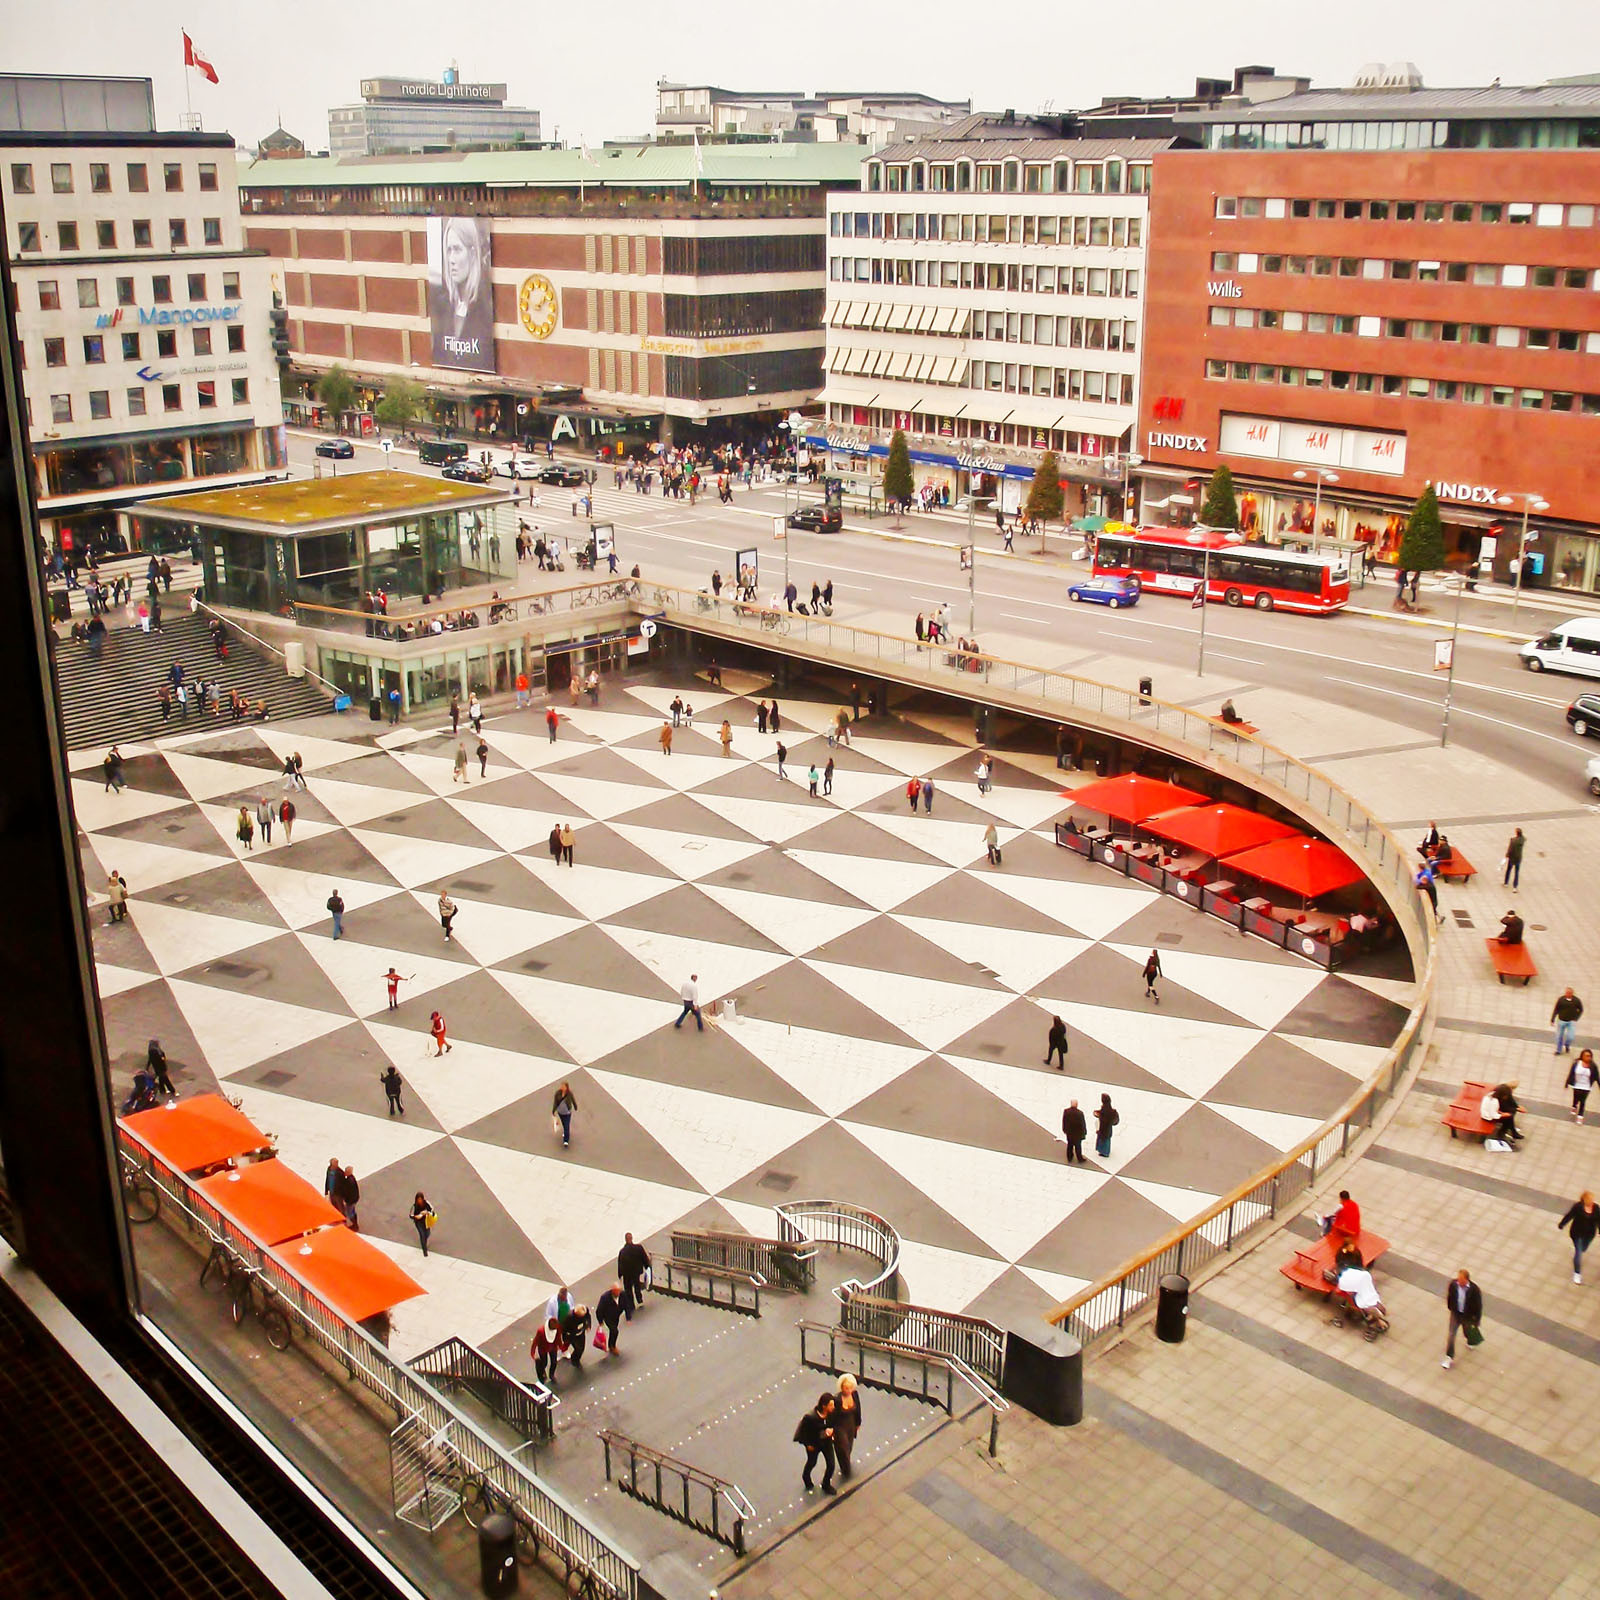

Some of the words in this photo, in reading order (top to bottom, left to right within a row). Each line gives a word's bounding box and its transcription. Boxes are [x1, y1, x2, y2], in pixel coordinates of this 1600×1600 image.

[401, 83, 436, 95] nordic
[465, 85, 491, 97] hotel
[138, 304, 242, 327] Manpower
[444, 335, 471, 356] Filippa
[471, 338, 480, 354] K
[1148, 431, 1208, 452] LINDEX
[1425, 480, 1499, 505] INDEX
